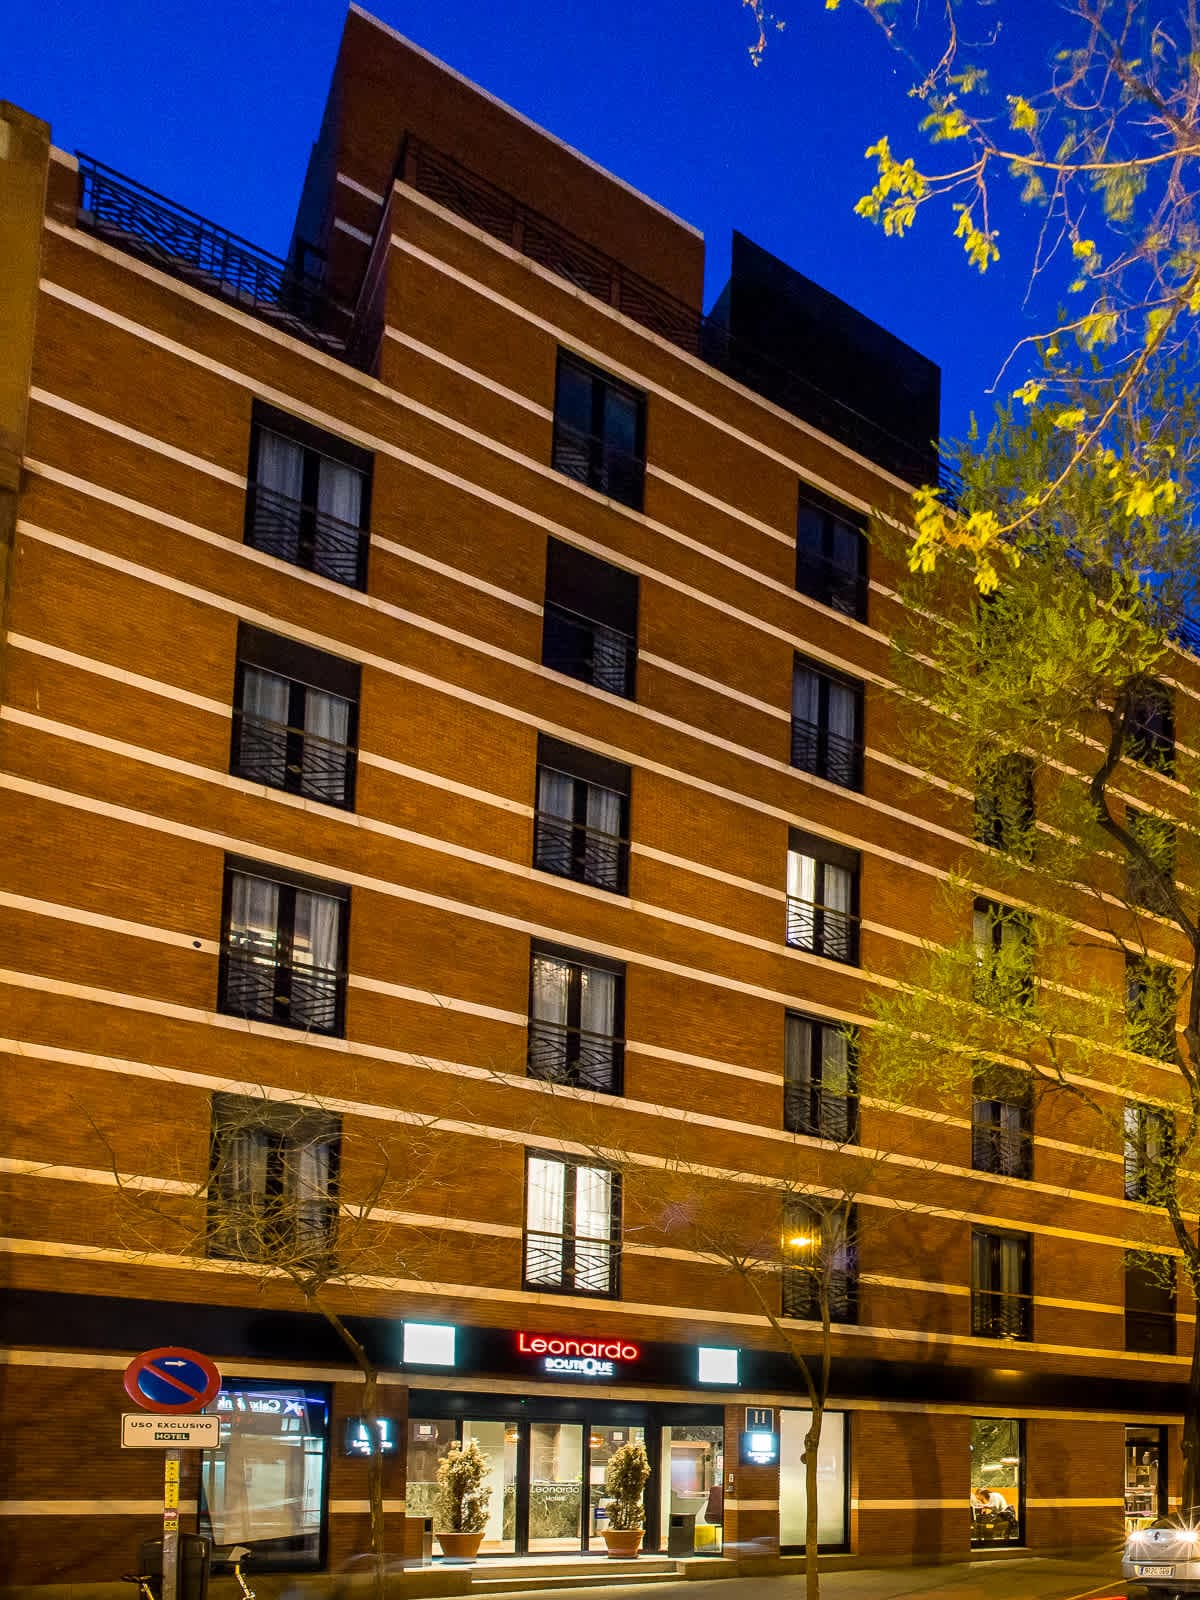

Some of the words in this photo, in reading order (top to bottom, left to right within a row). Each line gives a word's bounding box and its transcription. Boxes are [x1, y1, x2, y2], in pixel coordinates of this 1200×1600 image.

[519, 1333, 638, 1359] Leonardo
[544, 1358, 614, 1376] BOUTIQUE
[156, 1432, 187, 1440] HOTEL
